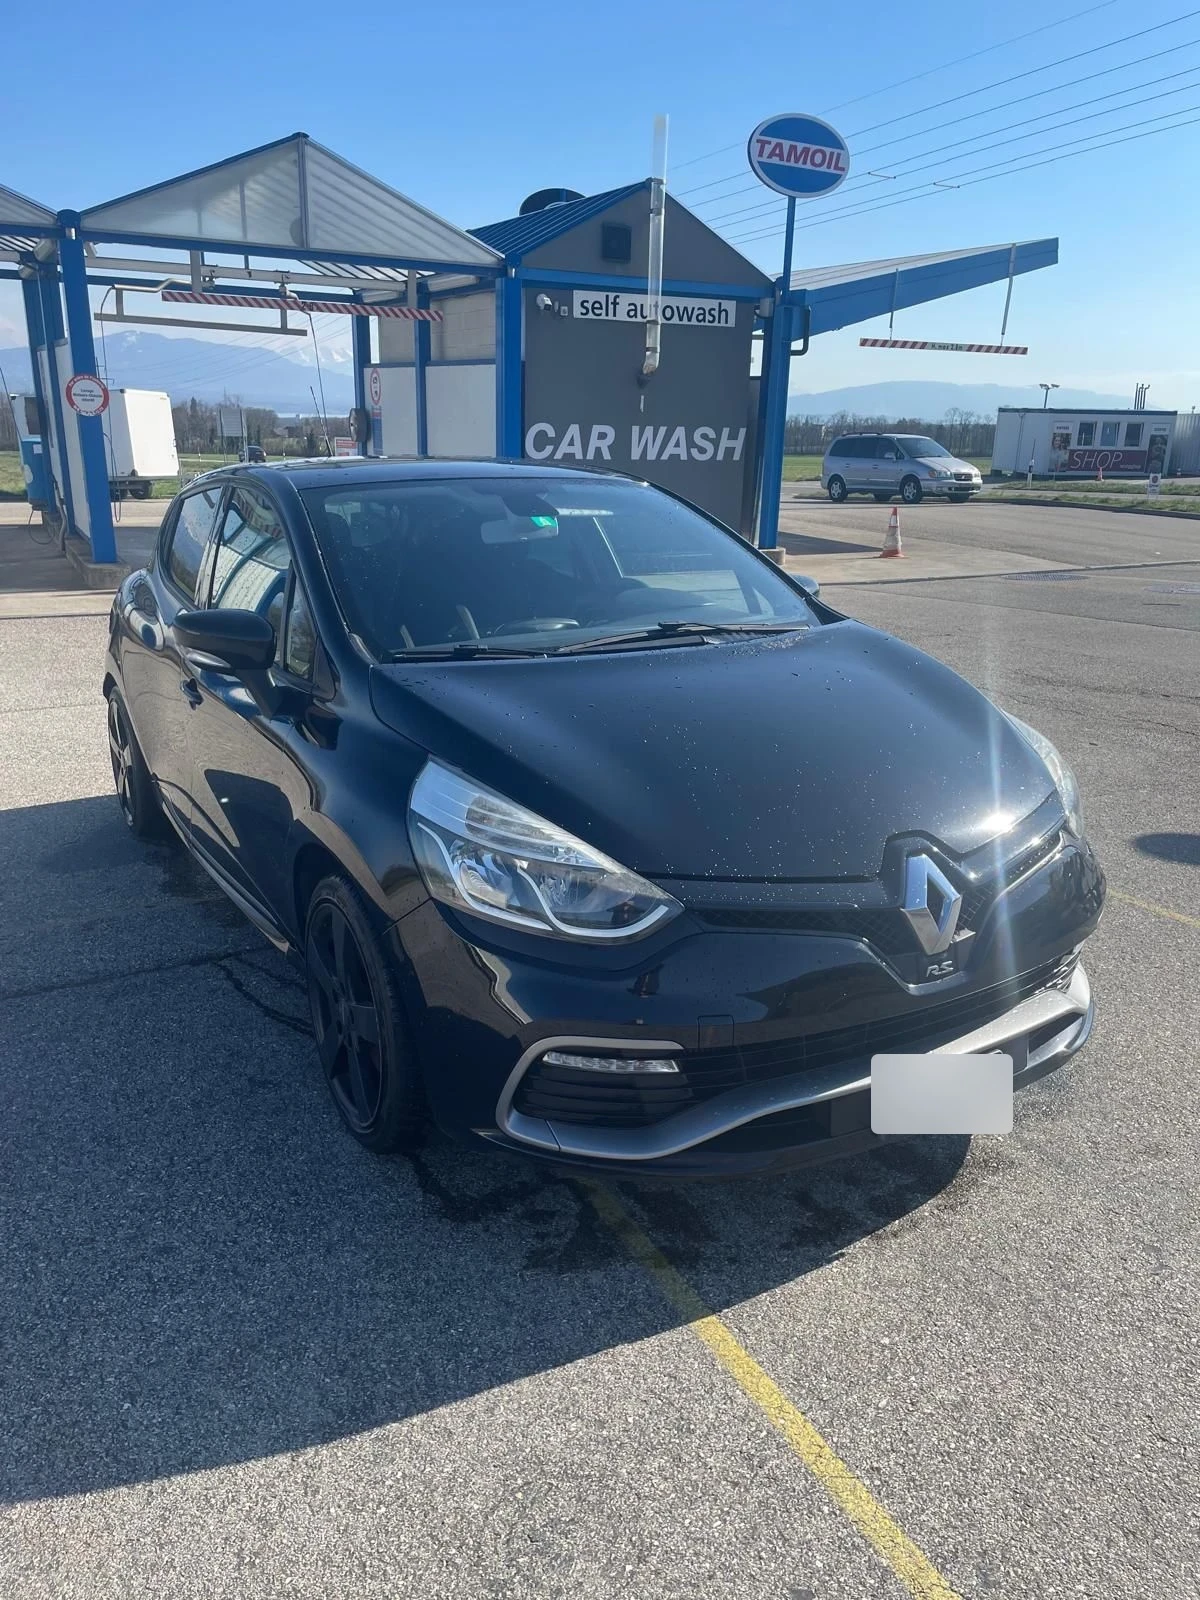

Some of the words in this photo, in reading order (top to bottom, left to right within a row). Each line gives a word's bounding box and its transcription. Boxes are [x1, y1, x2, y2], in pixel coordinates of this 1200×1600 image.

[756, 139, 846, 172] TAMOIL
[580, 294, 620, 318] self
[624, 301, 729, 325] autowash
[525, 423, 616, 460] CAR
[630, 426, 747, 461] WASH
[1070, 451, 1123, 469] SHOP
[926, 960, 954, 977] RS
